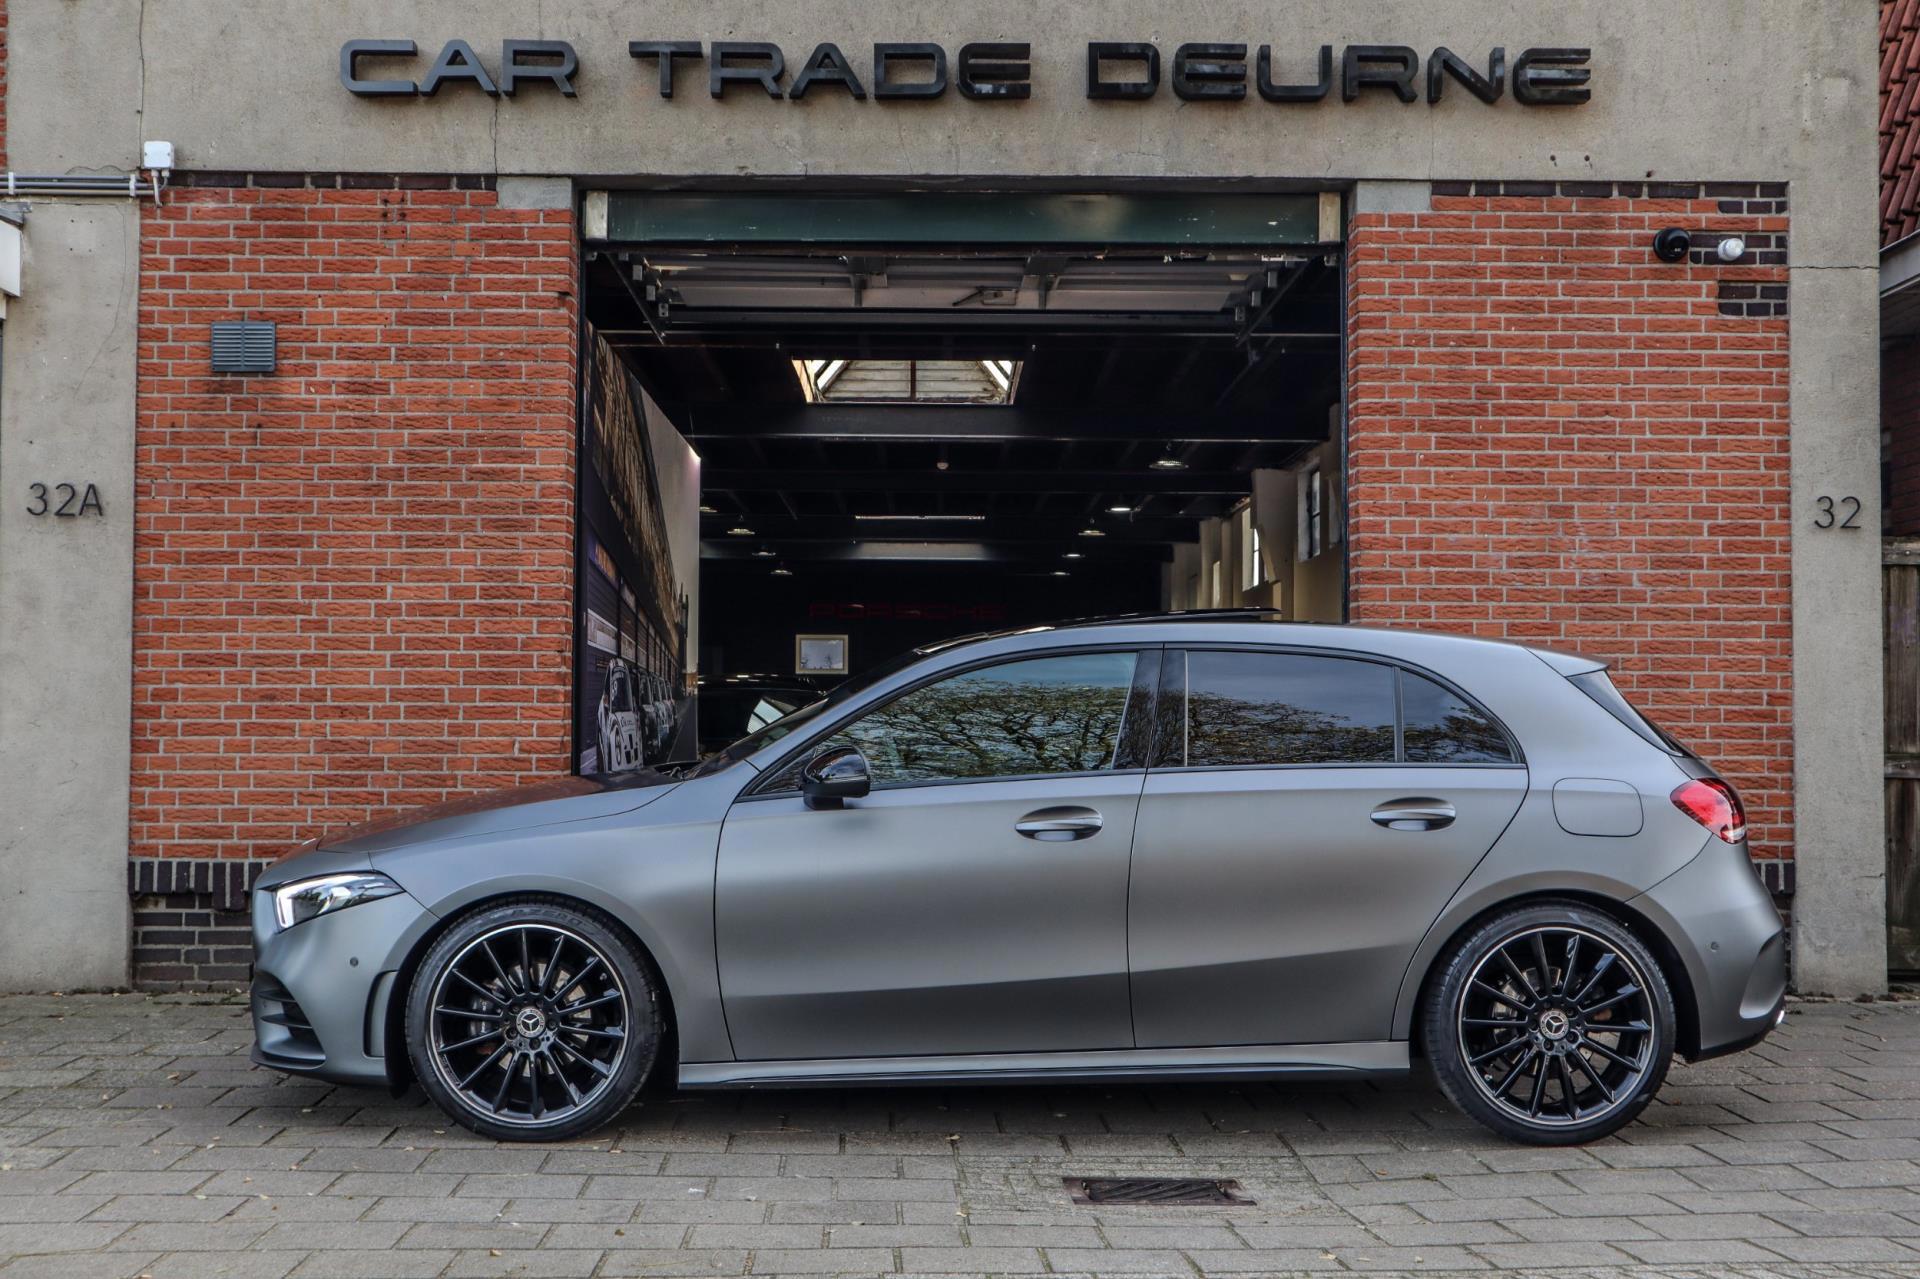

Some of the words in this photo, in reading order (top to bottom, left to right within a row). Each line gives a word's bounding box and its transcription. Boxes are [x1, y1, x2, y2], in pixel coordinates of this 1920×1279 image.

[340, 39, 578, 98] CAR
[629, 41, 1031, 100] TRADE
[1086, 42, 1591, 105] DEURNE
[26, 482, 103, 516] 32A
[1814, 495, 1861, 528] 32
[808, 603, 1008, 620] PORSCHE
